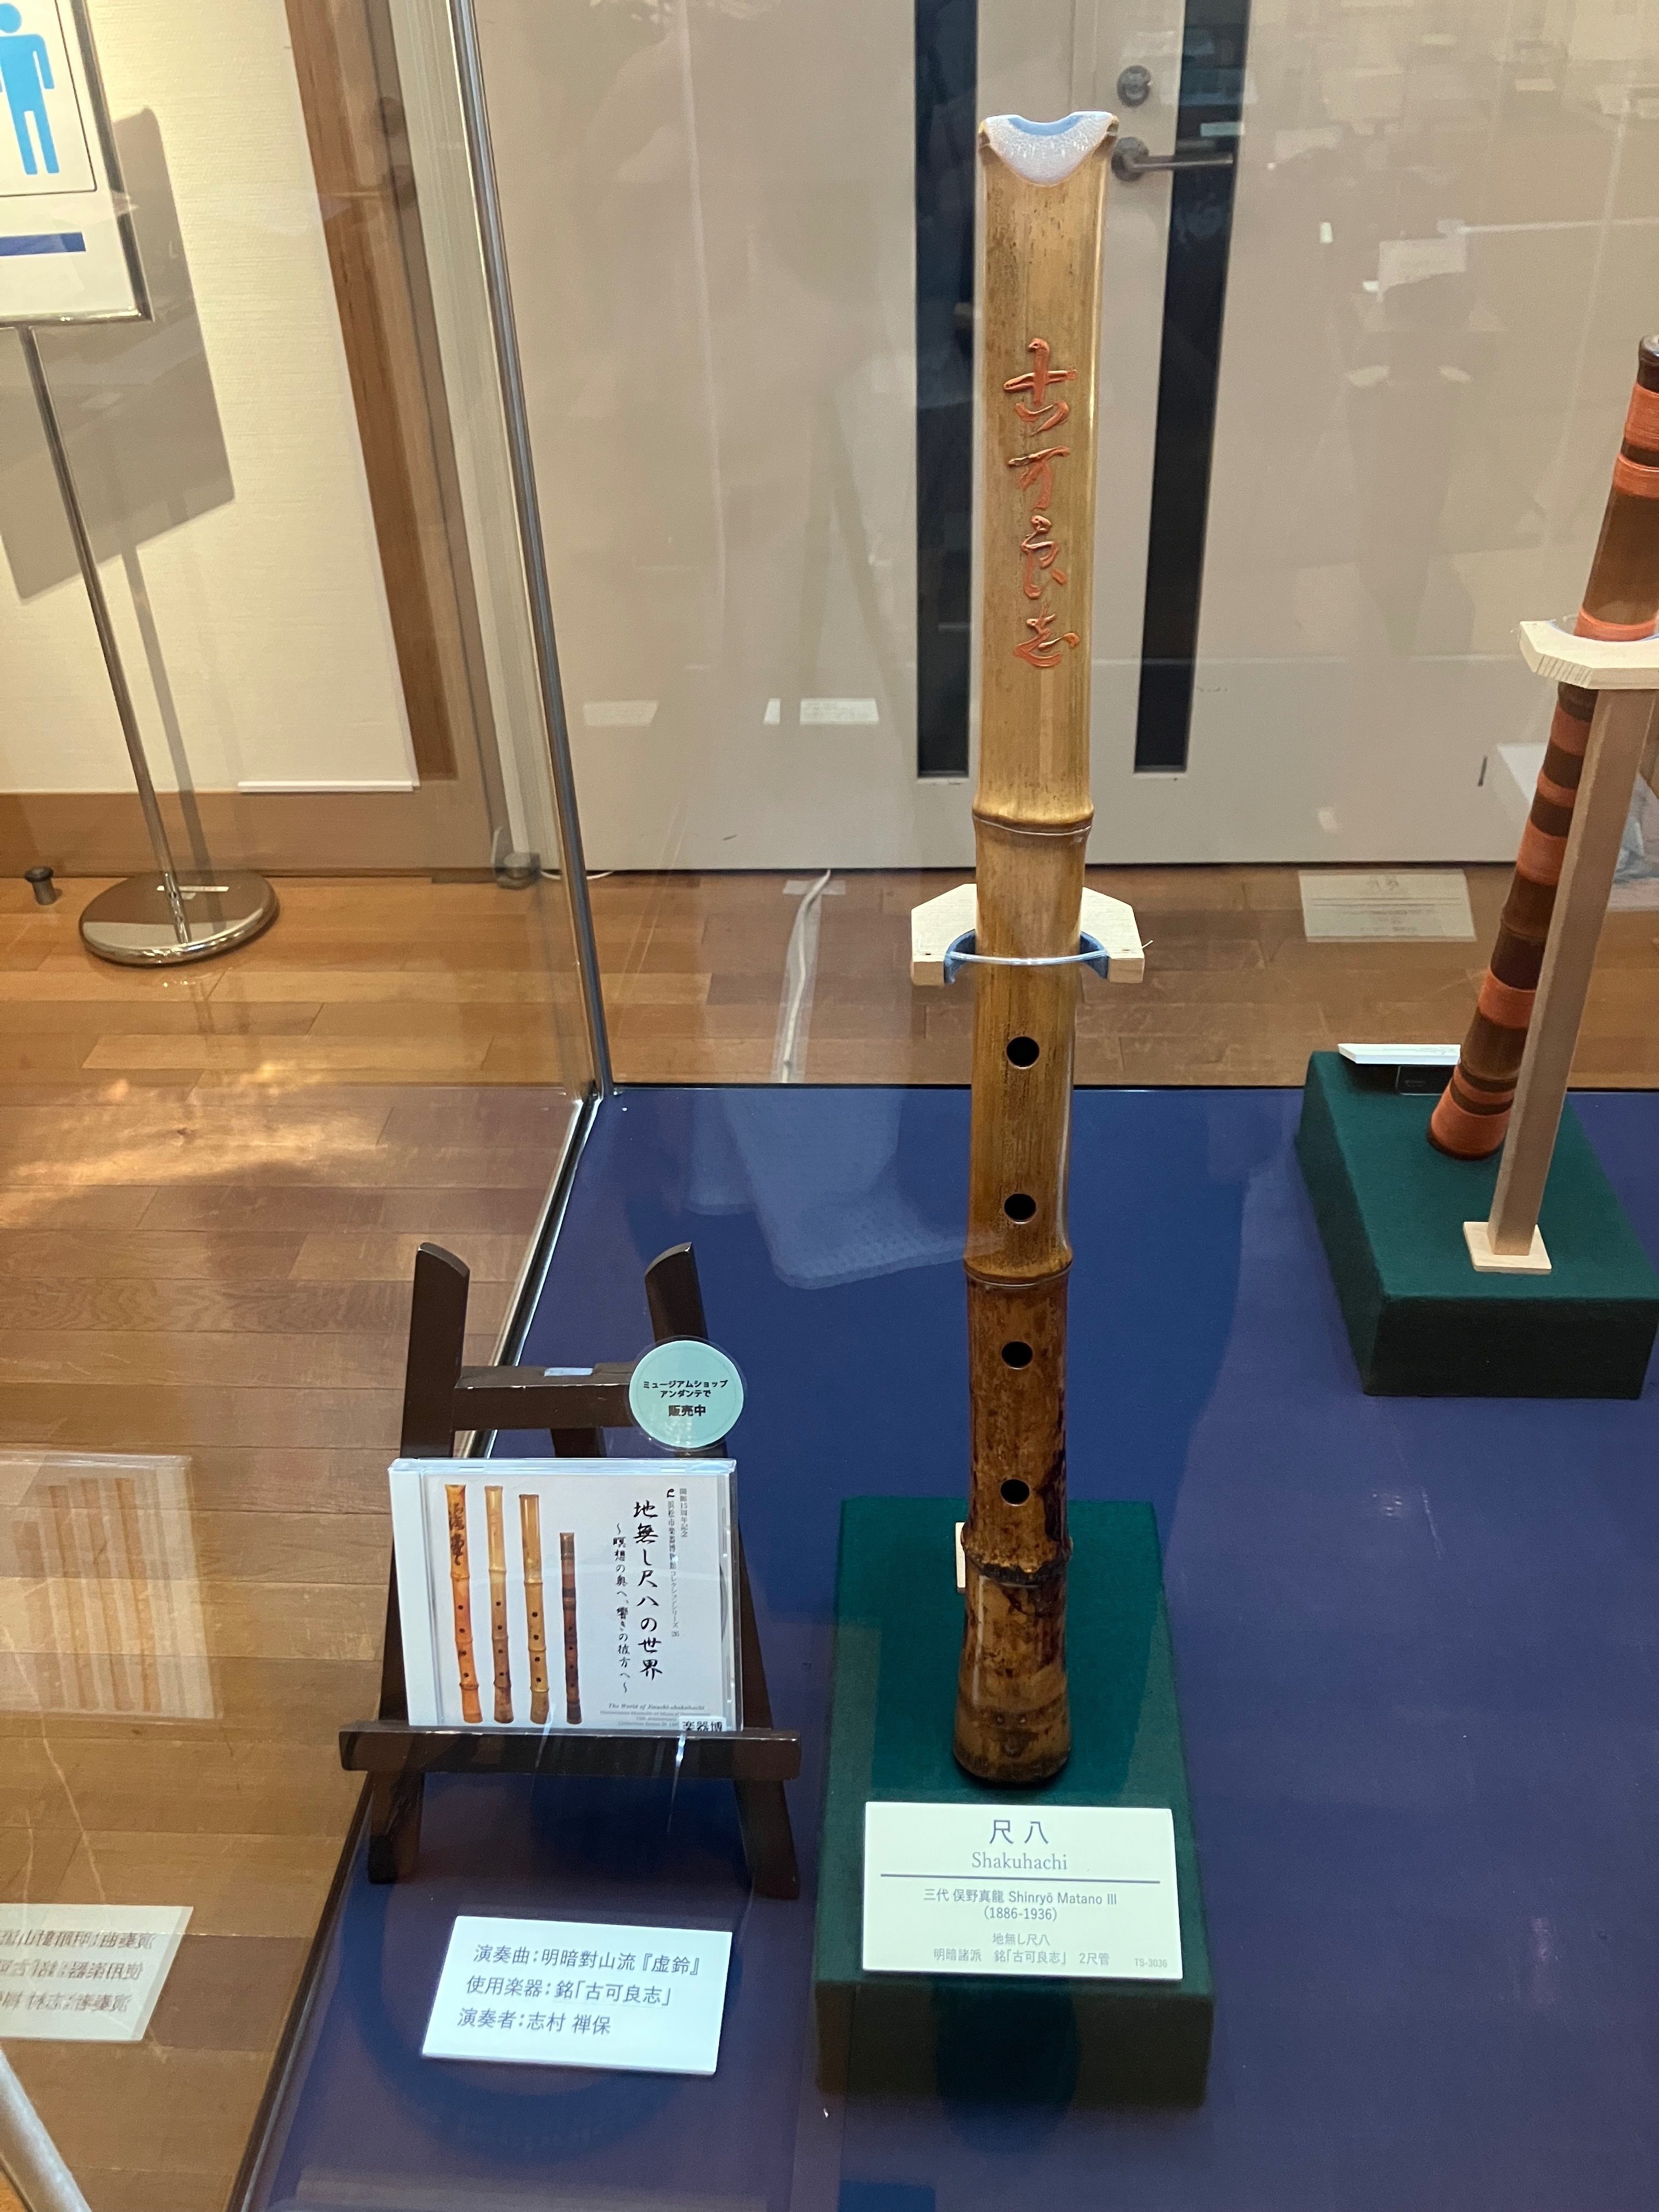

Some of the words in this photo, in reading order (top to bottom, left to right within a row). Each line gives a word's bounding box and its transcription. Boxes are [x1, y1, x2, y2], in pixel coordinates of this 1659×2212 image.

[643, 1380, 729, 1389] ミュージアムショップ
[660, 1390, 712, 1398] アンダンテで
[668, 1404, 707, 1417] 販売中
[633, 1499, 663, 1681] 地無し尺八の世界
[971, 1852, 1068, 1871] Shakuhachi
[923, 1888, 950, 1902] 三代
[1008, 1891, 1053, 1905] Shinryō
[1057, 1893, 1103, 1905] Matano
[1107, 1894, 1117, 1905] III
[984, 1906, 1058, 1921] (1886-1936)
[992, 1933, 1051, 1946] 地無し尺八
[934, 1948, 982, 1962] 明暗諸派
[1079, 1952, 1110, 1966] 2尺管
